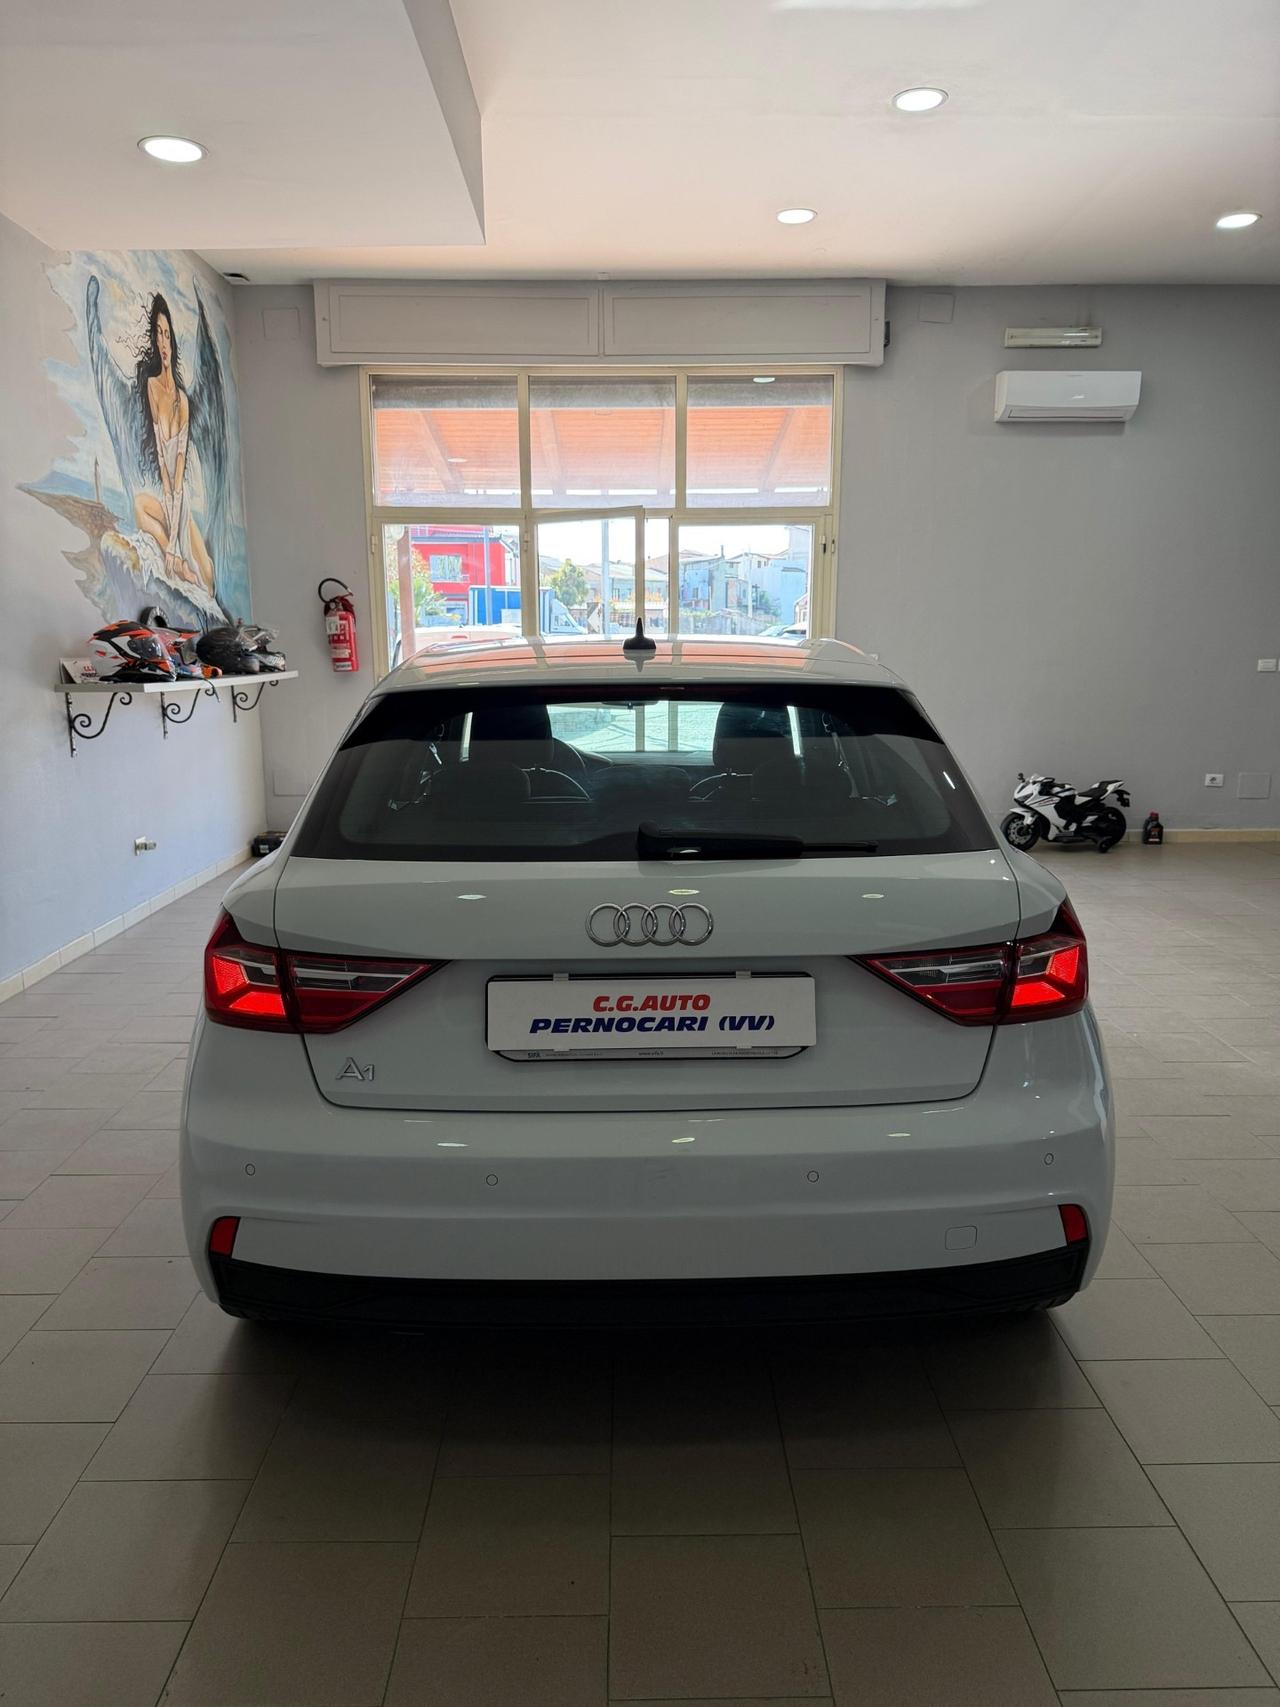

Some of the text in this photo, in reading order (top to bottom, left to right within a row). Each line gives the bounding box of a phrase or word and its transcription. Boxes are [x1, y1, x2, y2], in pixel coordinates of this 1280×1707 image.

[593, 994, 711, 1012] C.G.AUTO
[530, 1015, 775, 1034] PERNOCARI (VV)
[335, 1056, 375, 1081] A1
